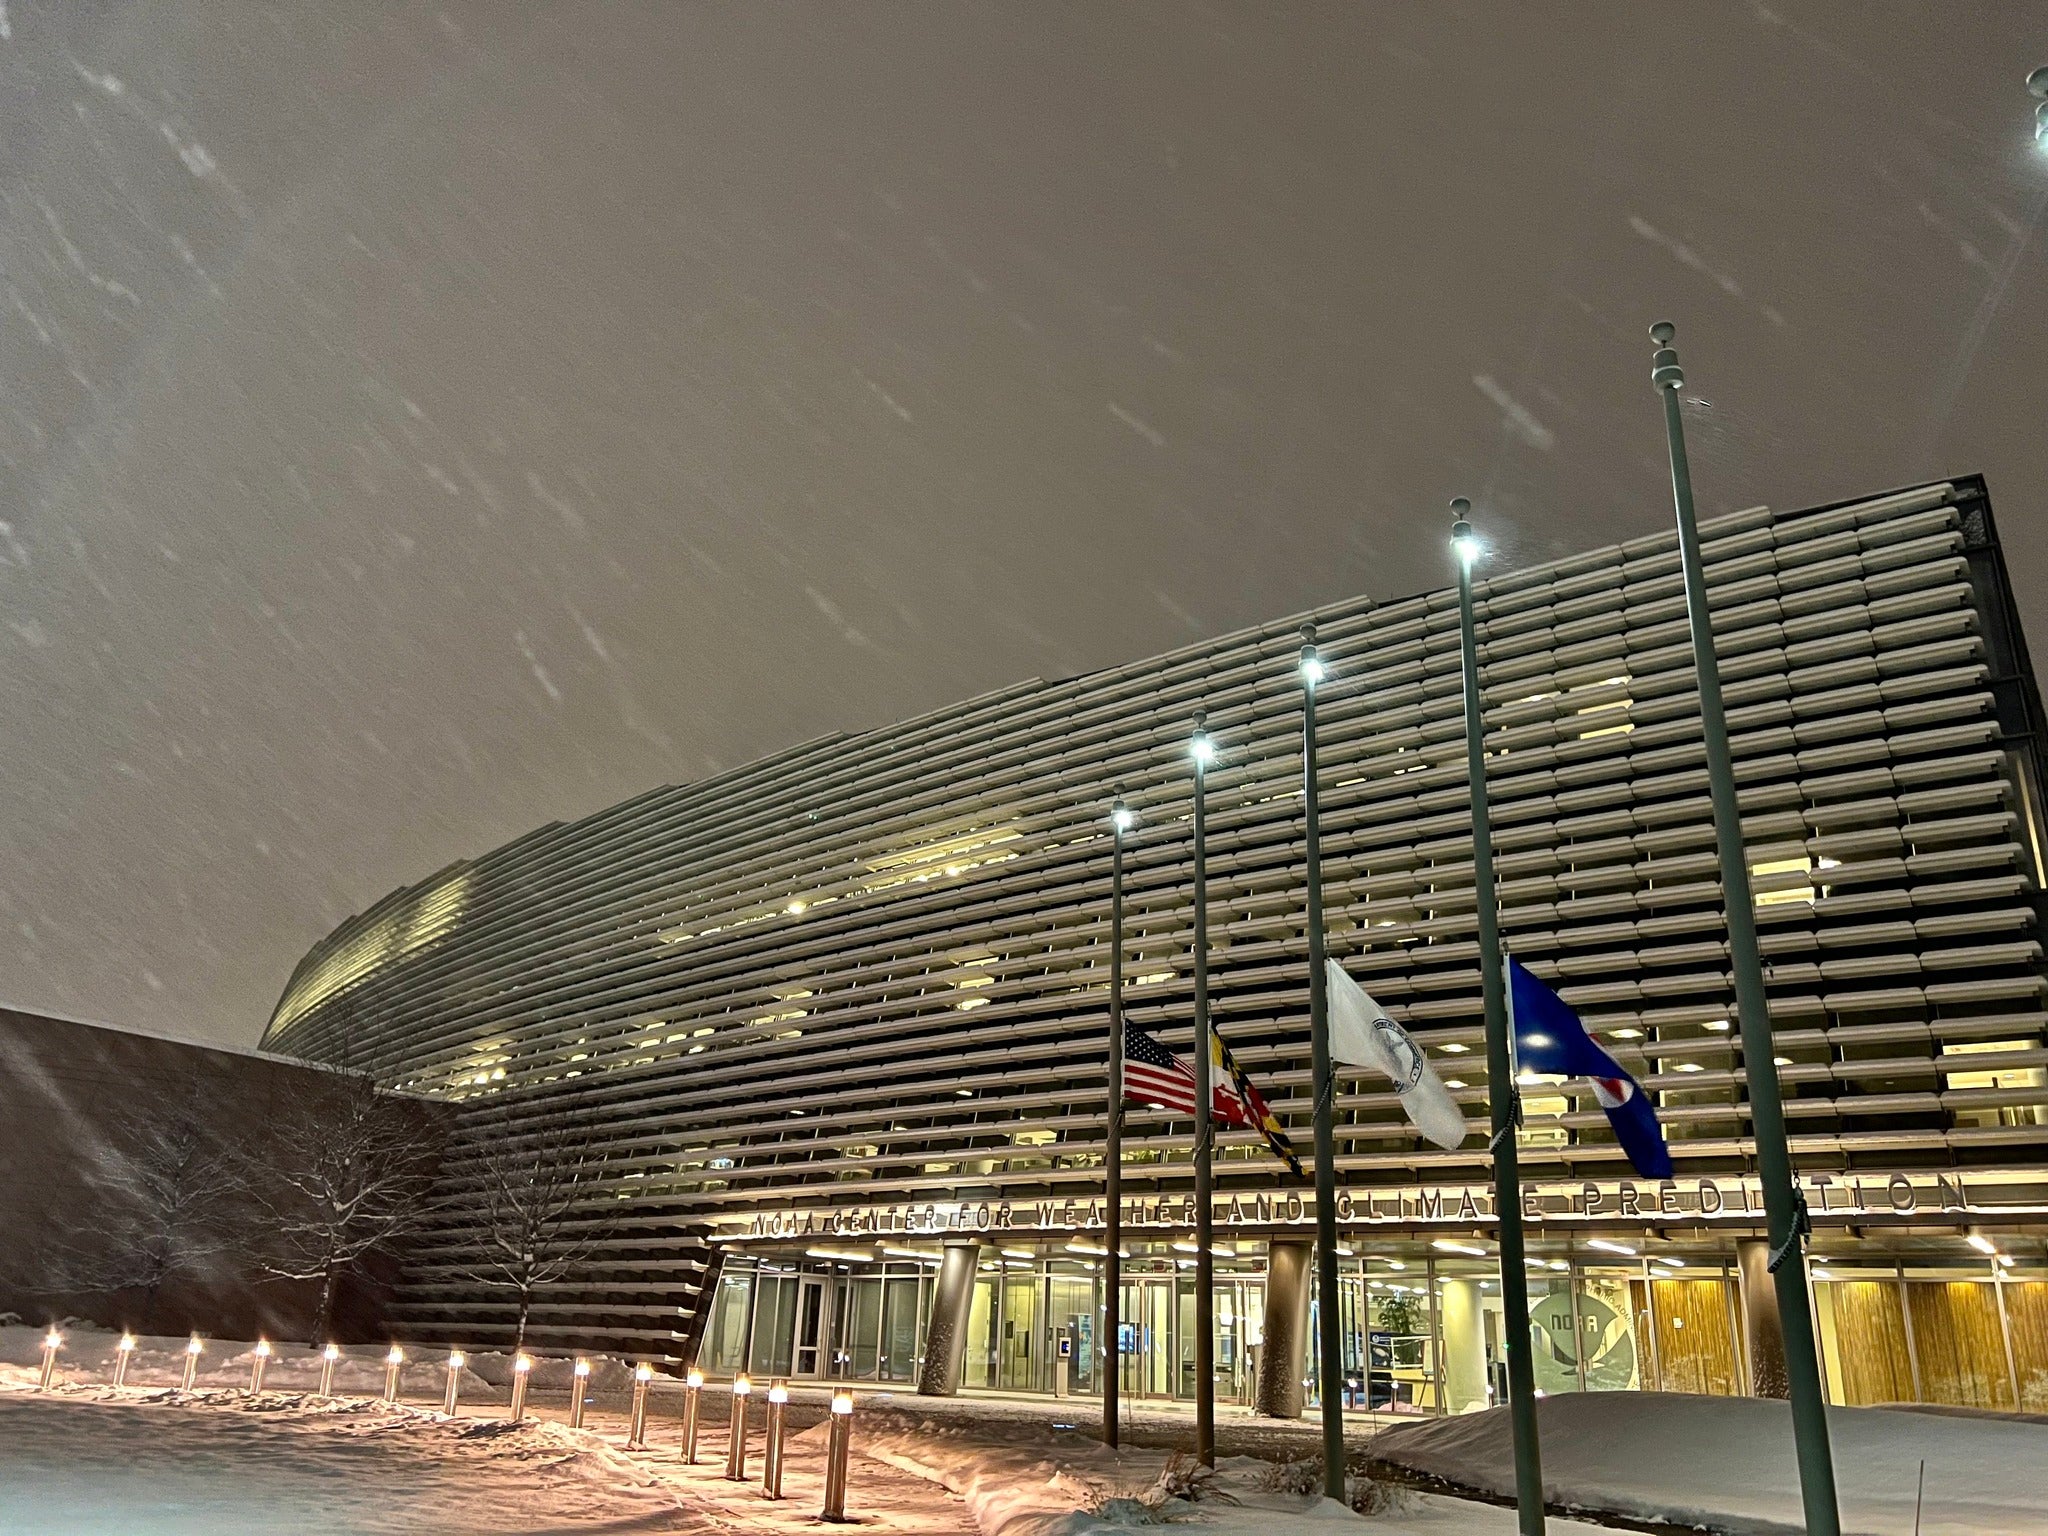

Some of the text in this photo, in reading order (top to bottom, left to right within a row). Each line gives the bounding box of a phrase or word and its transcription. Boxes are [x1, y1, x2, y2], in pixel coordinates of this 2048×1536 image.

[756, 1209, 815, 1235] NOAA
[832, 1203, 937, 1232] CENTER
[957, 1201, 1013, 1229] FOR
[1036, 1193, 1196, 1228] WEAHER
[1226, 1191, 1303, 1223] AND
[1582, 1173, 1968, 1216] PREDITION
